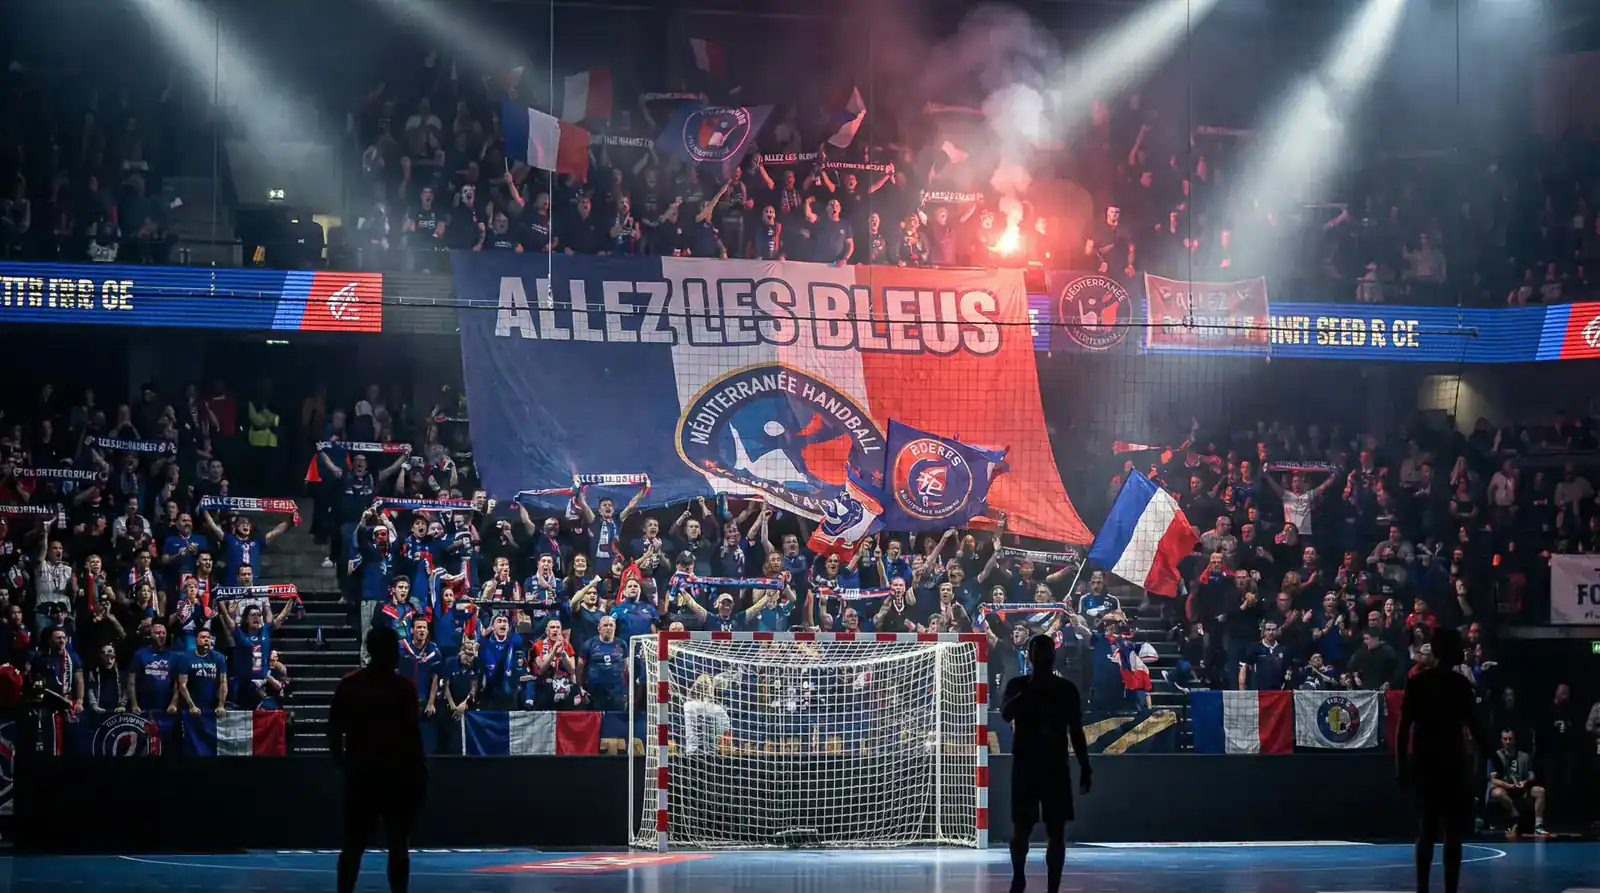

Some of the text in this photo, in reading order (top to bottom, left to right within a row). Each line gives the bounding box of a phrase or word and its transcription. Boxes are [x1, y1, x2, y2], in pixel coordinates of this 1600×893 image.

[764, 154, 784, 162] ALLEZ
[785, 153, 797, 161] LES
[494, 275, 1003, 357] ALLEZ LES BLEUS
[689, 370, 883, 455] MÉDITERRANÉE HANDBALL
